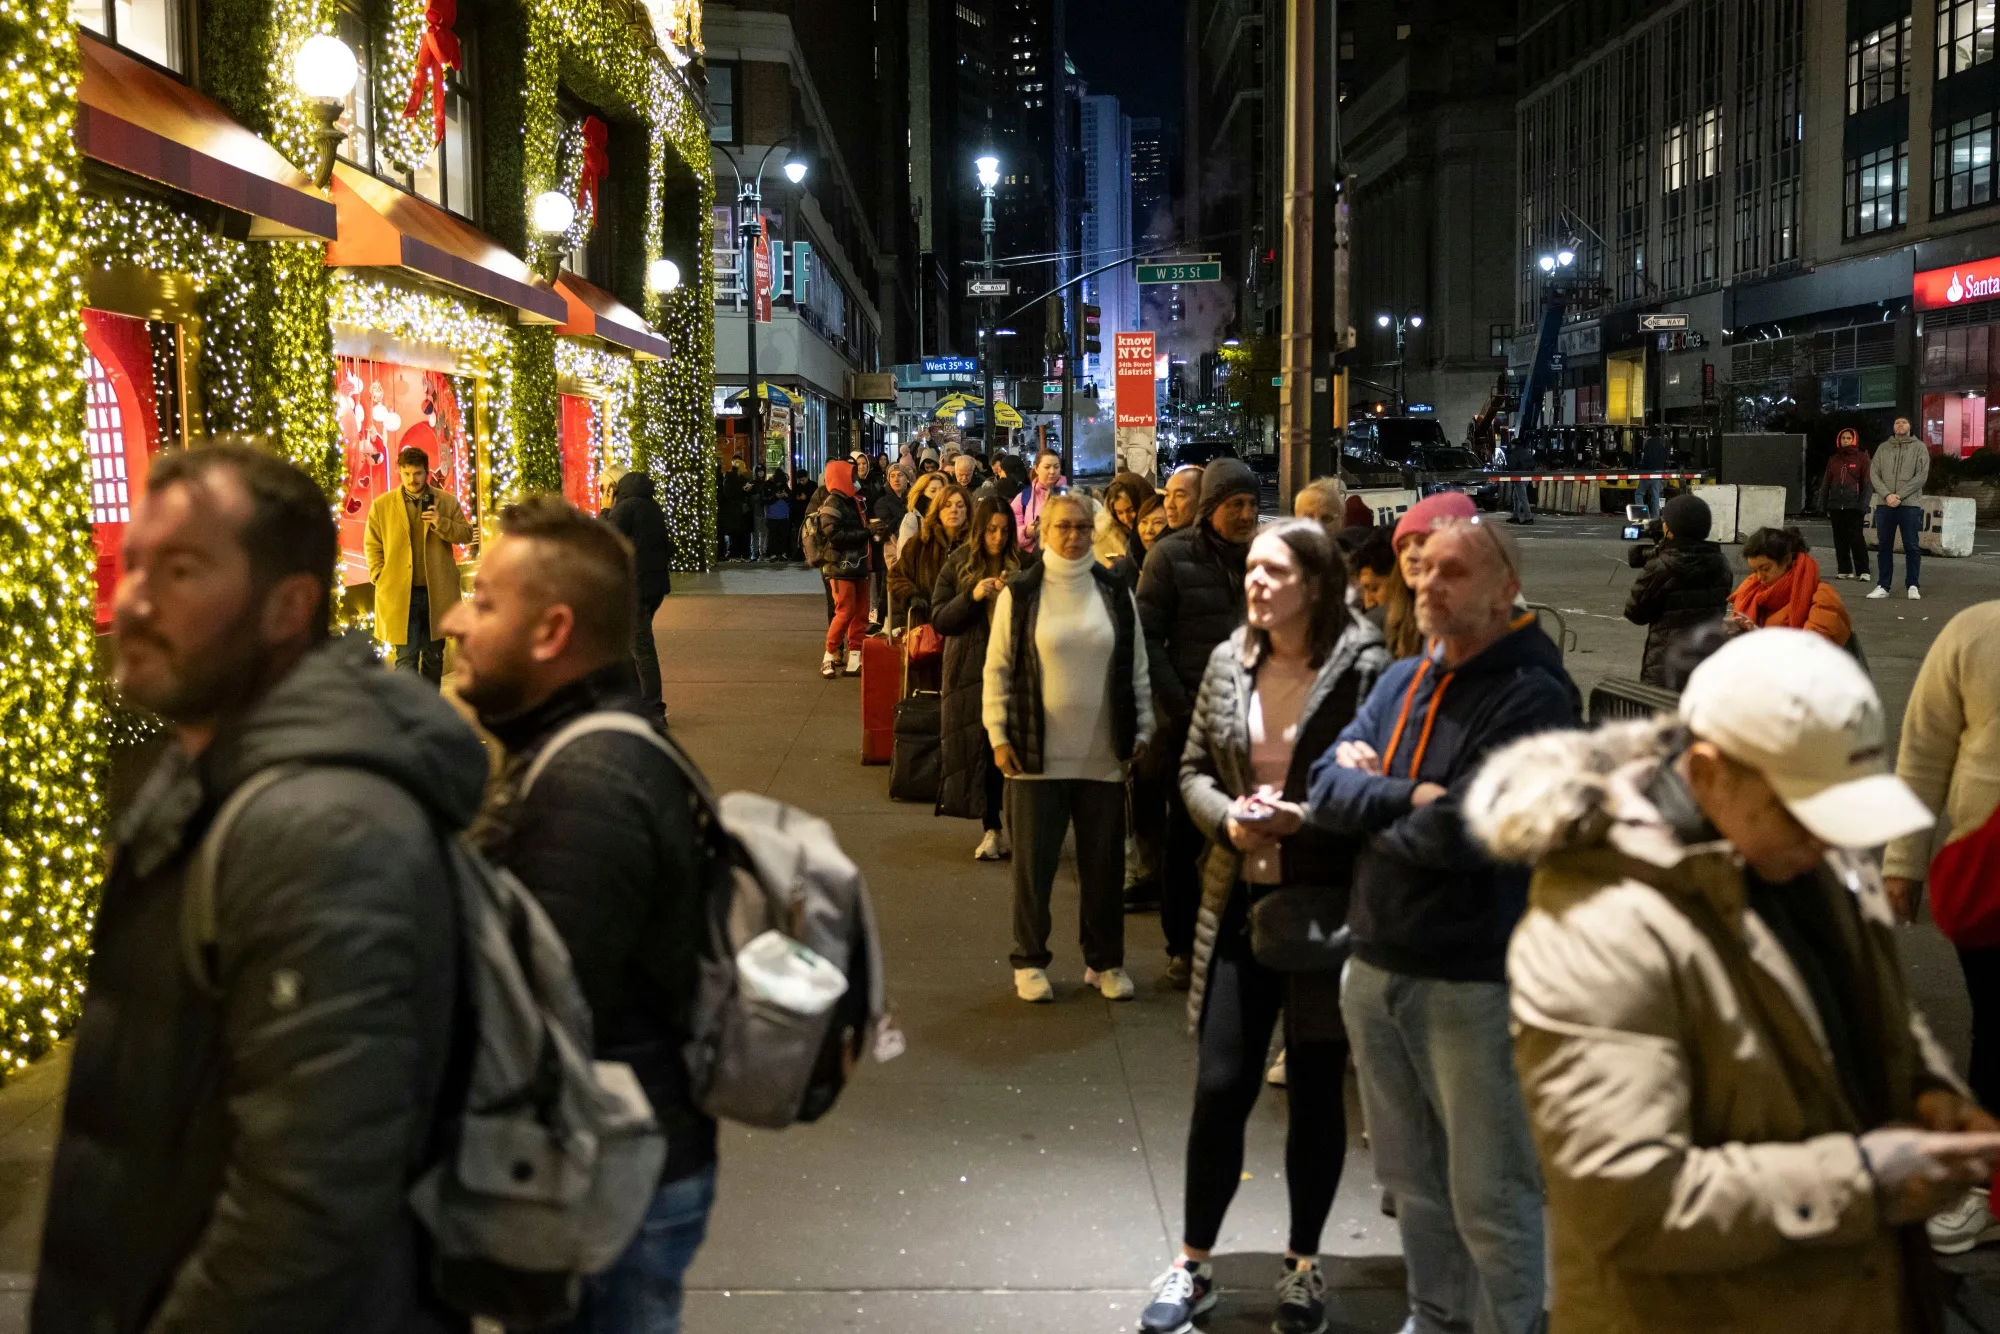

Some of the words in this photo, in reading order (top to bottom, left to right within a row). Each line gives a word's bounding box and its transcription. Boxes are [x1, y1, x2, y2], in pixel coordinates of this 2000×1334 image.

[1156, 268, 1167, 280] W
[1171, 267, 1185, 279] 35
[1189, 266, 1201, 278] St
[1965, 274, 2000, 299] Santa
[1666, 318, 1681, 326] WAY
[1117, 335, 1152, 346] know
[1117, 346, 1152, 359] NYC
[925, 361, 947, 371] West
[948, 361, 963, 371] 35th
[964, 361, 974, 370] St
[1118, 368, 1152, 376] district
[1118, 414, 1153, 424] Macy's
